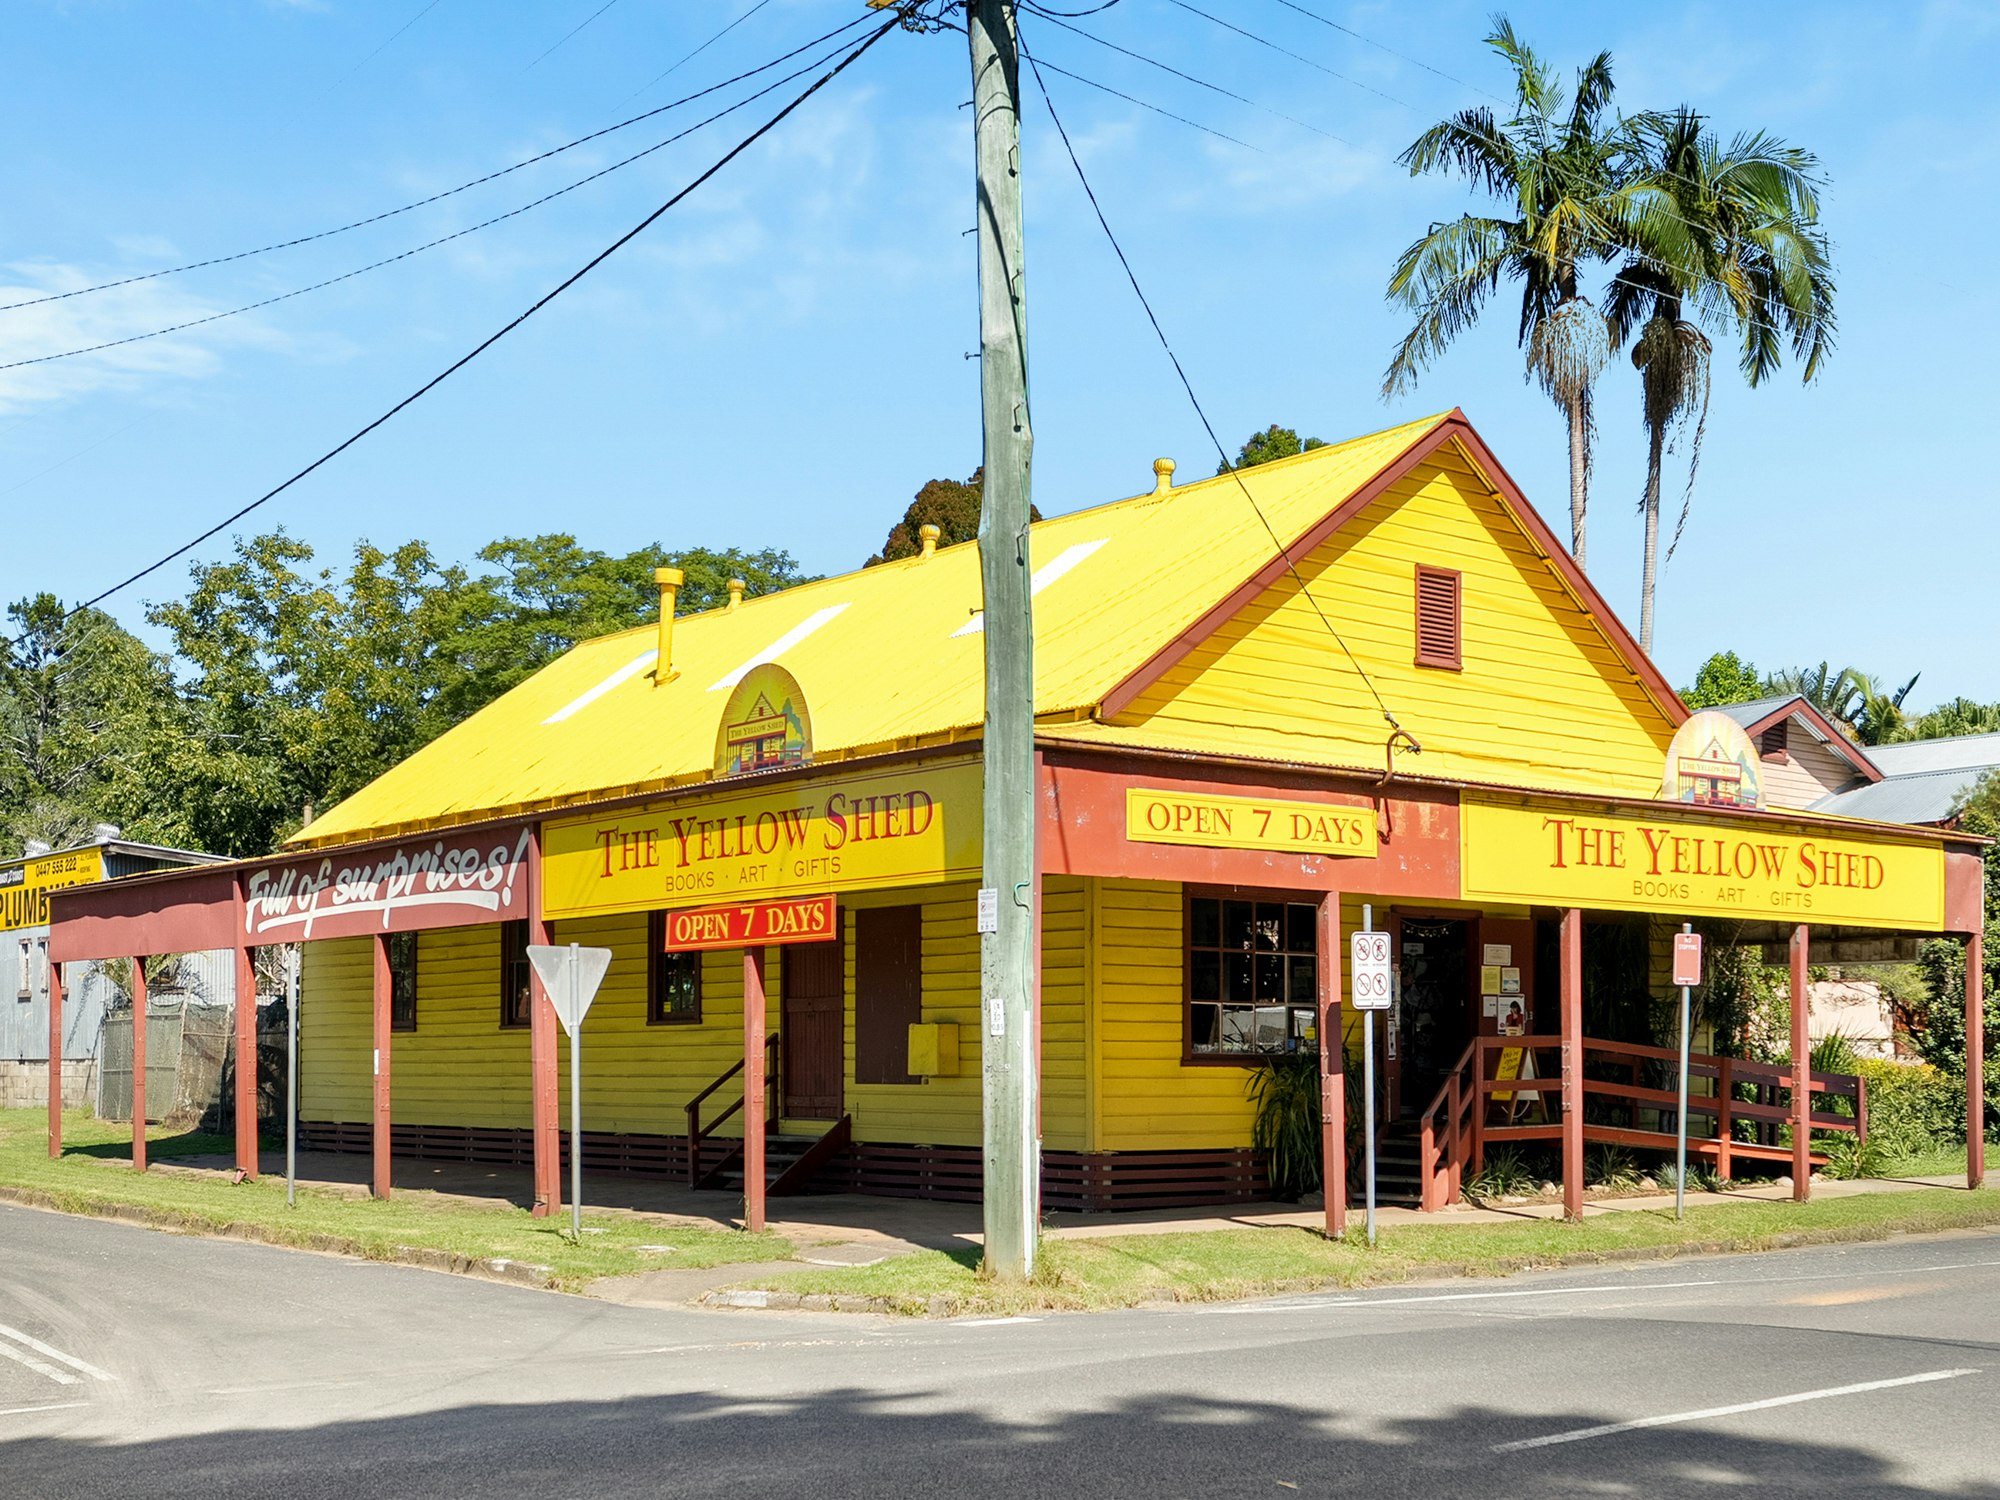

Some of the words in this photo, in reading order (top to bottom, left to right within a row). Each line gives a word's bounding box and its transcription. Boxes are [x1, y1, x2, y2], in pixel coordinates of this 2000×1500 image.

[595, 825, 660, 878] THE
[669, 806, 814, 868] YELLOW
[824, 790, 933, 850] SHED
[1146, 802, 1233, 836] OPEN
[1252, 809, 1272, 838] 7
[1290, 814, 1363, 845] DAYS
[35, 862, 51, 878] 0447
[52, 860, 64, 875] 555
[65, 857, 77, 872] 222
[1542, 816, 1626, 868] THE
[1636, 827, 1789, 881] YELLOW
[1796, 842, 1884, 890] SHED
[245, 868, 297, 935] Full
[299, 857, 332, 939] of
[331, 826, 530, 930] surprises!
[665, 871, 715, 892] BOOKS
[739, 864, 768, 884] ART
[794, 856, 841, 877] GIFTS
[1633, 880, 1690, 899] BOOKS
[1716, 887, 1745, 903] ART
[1770, 891, 1813, 908] GIFTS
[675, 913, 730, 942] OPEN
[740, 907, 755, 937] 7
[766, 903, 825, 935] DAYS
